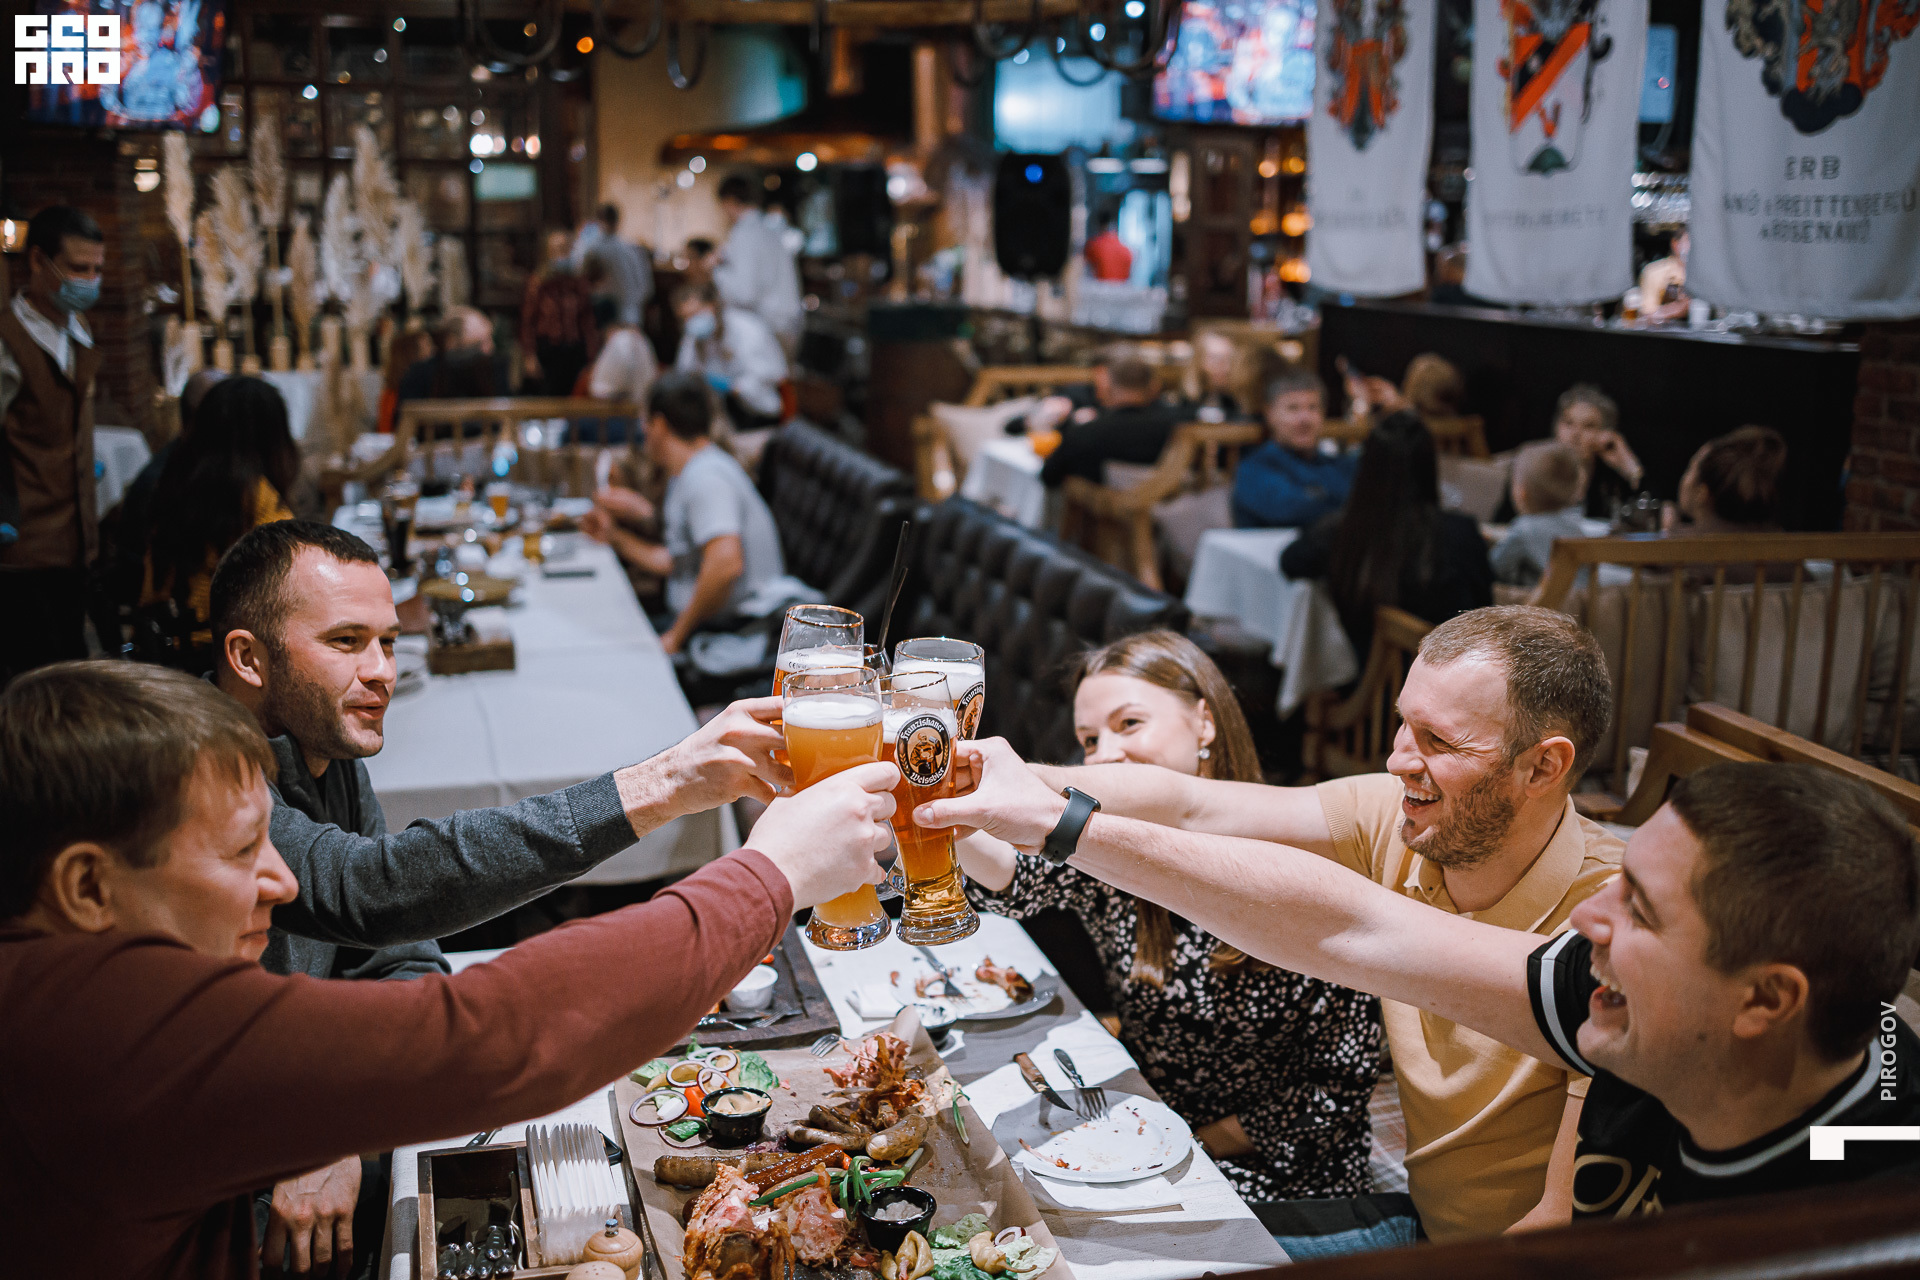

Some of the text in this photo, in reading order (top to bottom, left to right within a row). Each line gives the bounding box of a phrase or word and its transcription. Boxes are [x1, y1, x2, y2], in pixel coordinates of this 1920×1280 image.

[1784, 156, 1841, 180] ERB
[900, 717, 946, 741] Franziskaner
[909, 767, 945, 784] Weissbier
